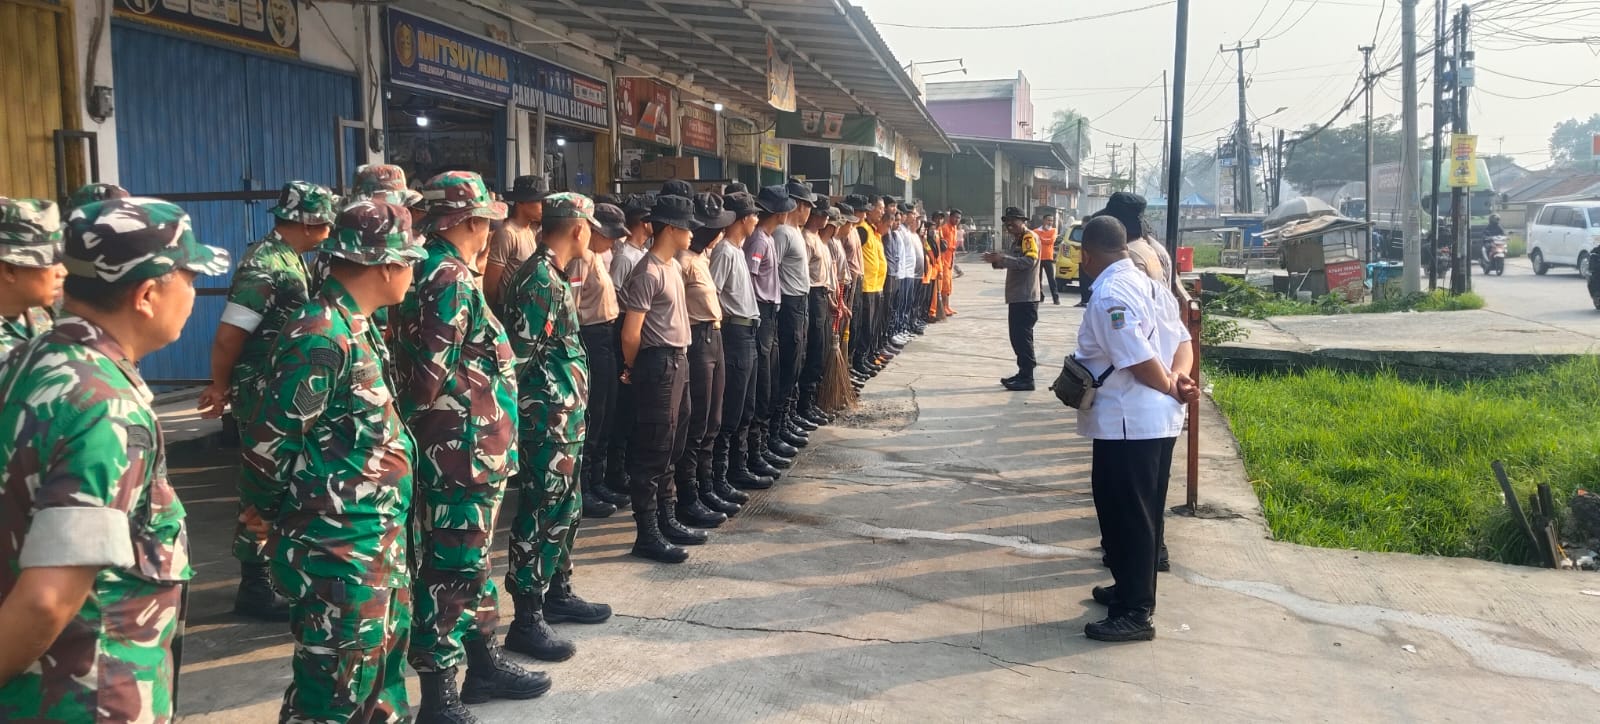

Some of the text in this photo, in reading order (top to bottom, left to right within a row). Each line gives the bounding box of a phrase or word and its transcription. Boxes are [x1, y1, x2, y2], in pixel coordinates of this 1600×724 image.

[417, 30, 508, 82] MITSUYAMA
[512, 83, 544, 107] CAHAYA
[546, 92, 569, 116] MULYA
[570, 99, 608, 126] ELEKTRONIK
